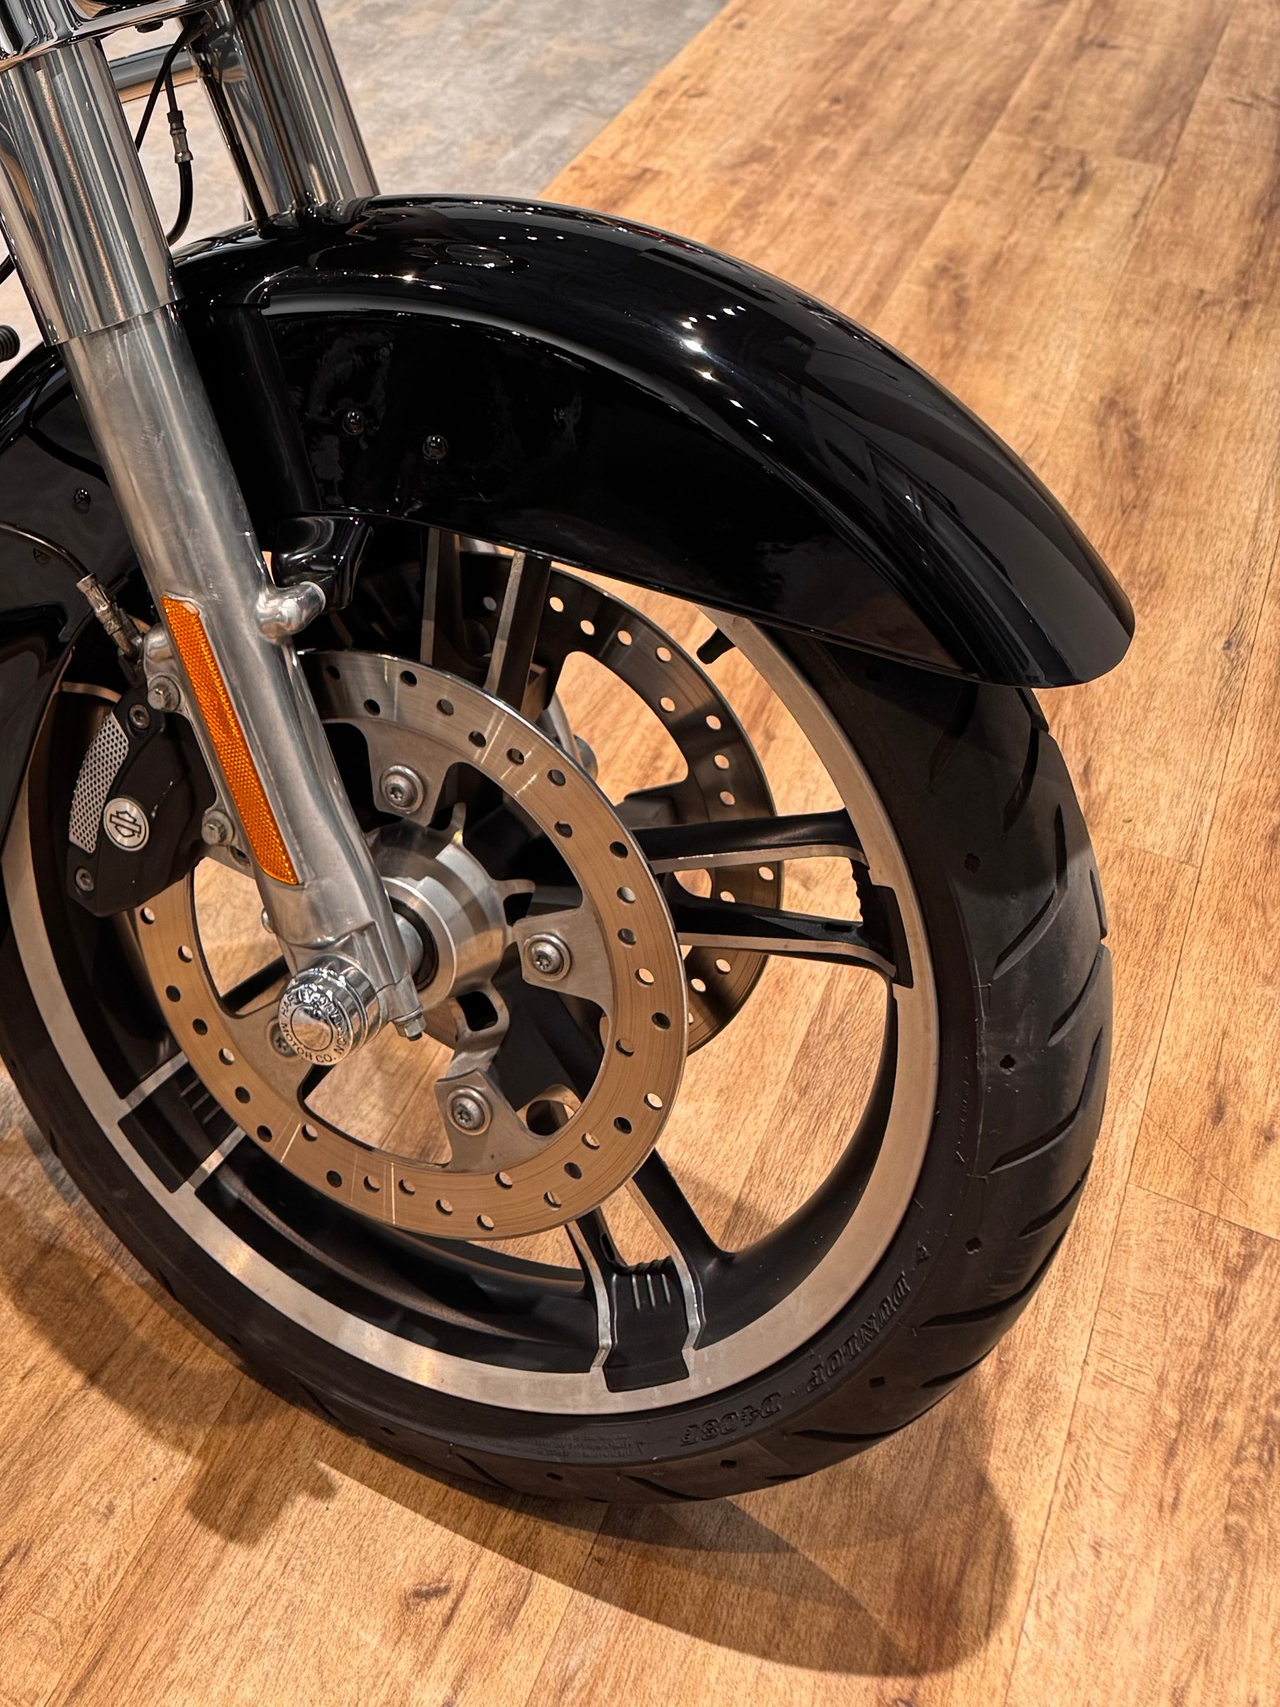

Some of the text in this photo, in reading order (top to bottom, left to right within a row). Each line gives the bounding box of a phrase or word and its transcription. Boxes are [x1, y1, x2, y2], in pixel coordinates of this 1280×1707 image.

[280, 1022, 313, 1061] MOTOR
[680, 1270, 913, 1447] DUNLOP D408F
